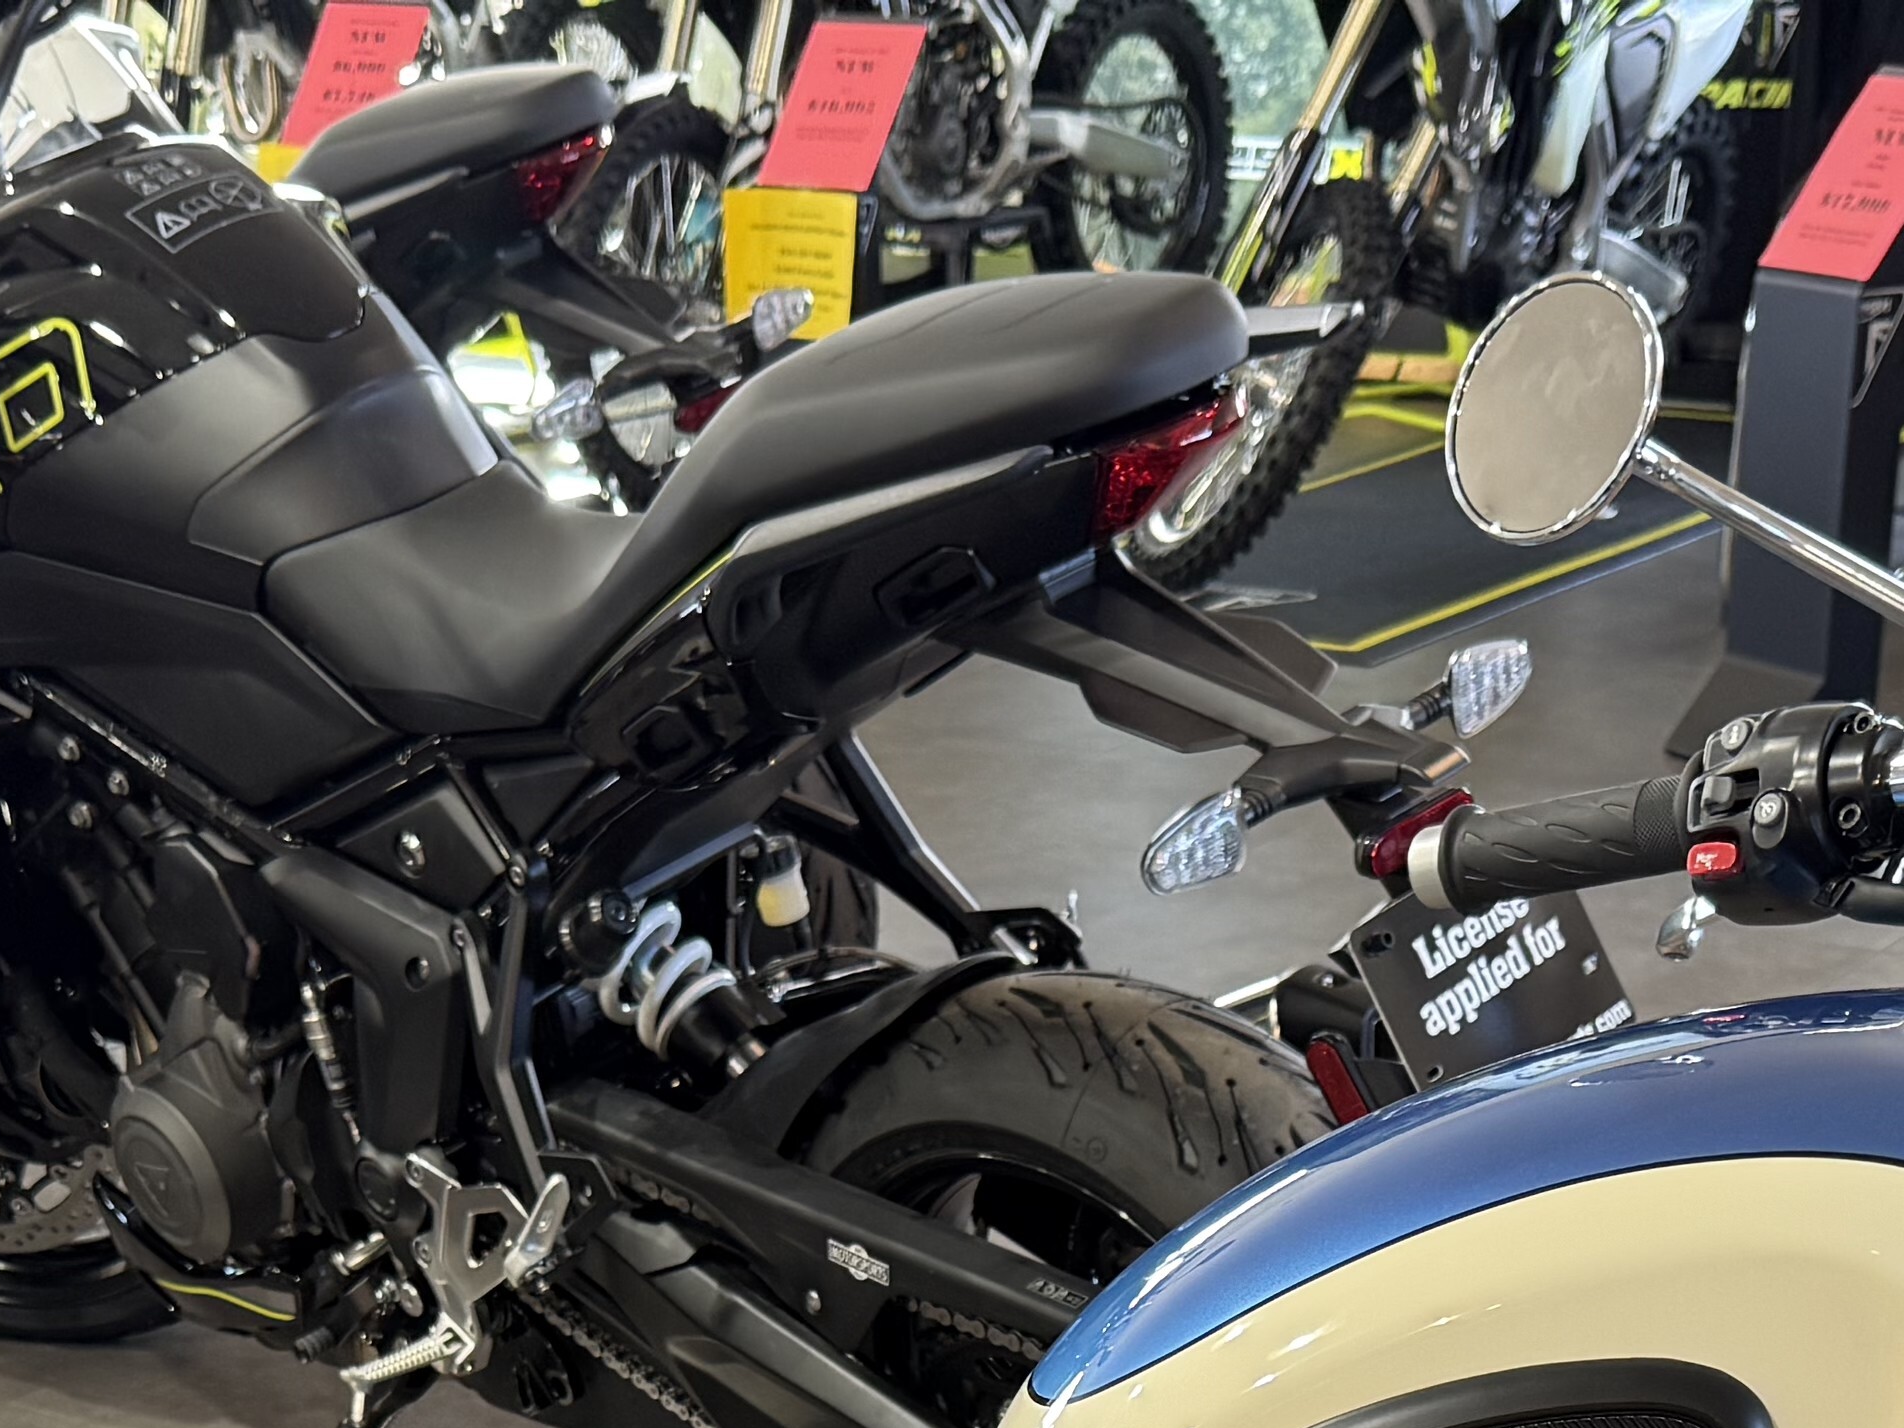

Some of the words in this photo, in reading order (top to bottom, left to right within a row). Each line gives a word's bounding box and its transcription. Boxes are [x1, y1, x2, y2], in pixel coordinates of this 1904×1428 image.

[1411, 897, 1530, 980] License
[1419, 934, 1532, 1037] applied
[1521, 916, 1567, 967] for
